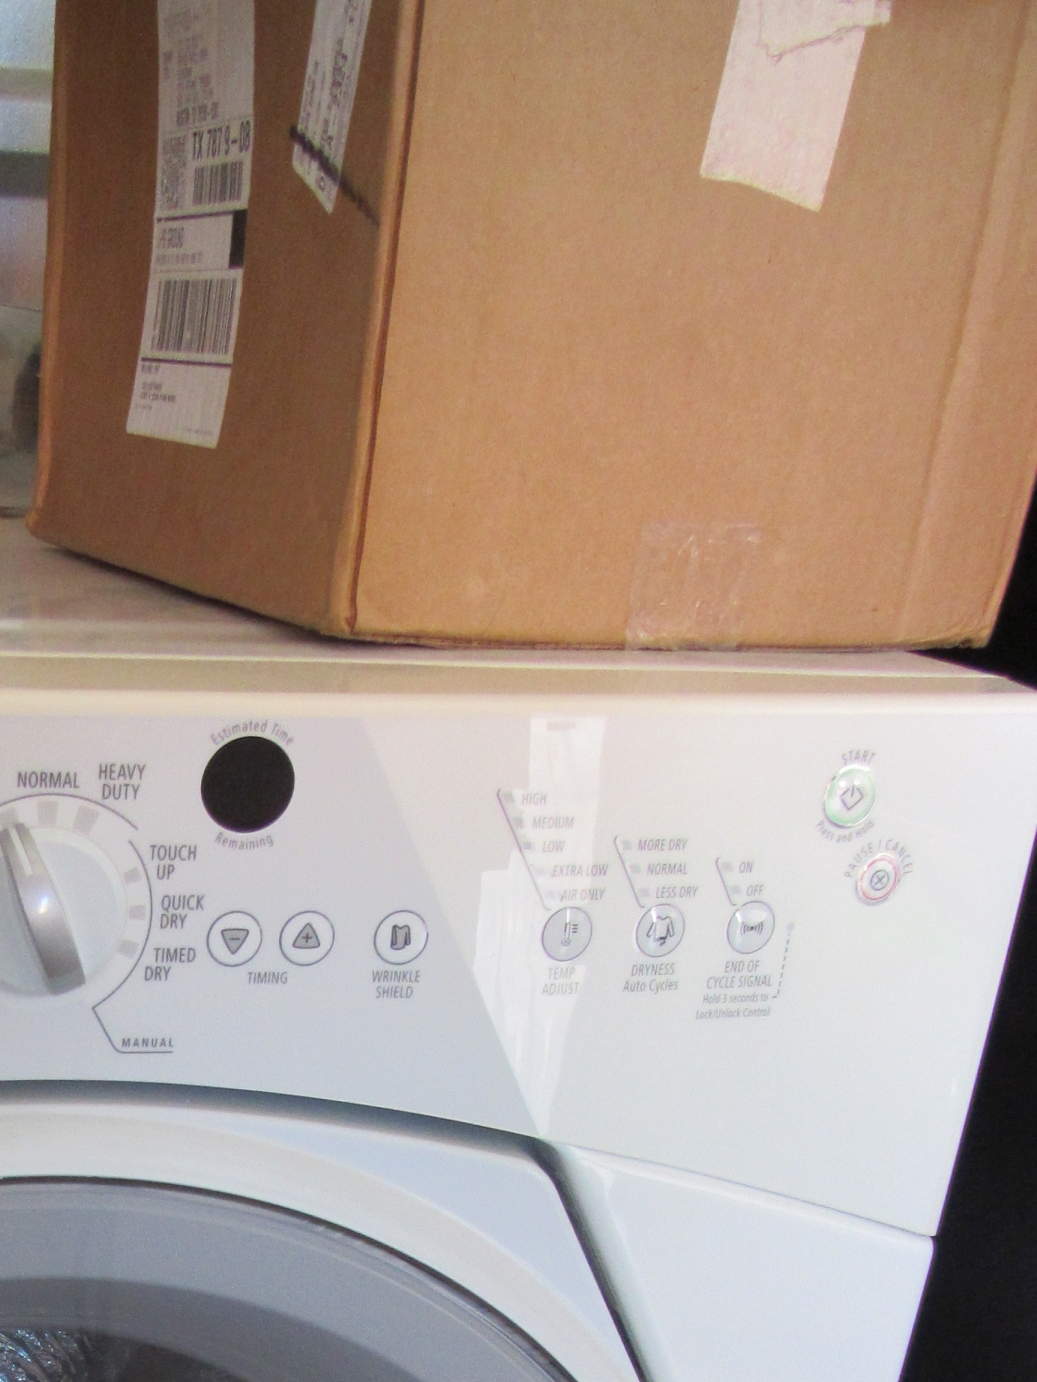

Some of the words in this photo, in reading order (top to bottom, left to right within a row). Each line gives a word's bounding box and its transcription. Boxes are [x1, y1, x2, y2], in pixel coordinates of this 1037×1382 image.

[210, 720, 268, 745] Estimated
[271, 723, 294, 745] Time
[842, 749, 876, 765] START
[98, 763, 147, 781] HEAVY
[17, 771, 81, 789] NORMAL
[101, 784, 142, 800] DUTY
[521, 793, 548, 806] HIGH
[532, 816, 575, 829] MEDIUM
[816, 819, 834, 841] Press
[836, 831, 852, 843] and
[214, 832, 274, 850] Remaining
[542, 841, 566, 853] LOW
[637, 838, 666, 851] MORE
[668, 838, 688, 851] DRY
[150, 844, 198, 862] TOUCH
[844, 842, 874, 878] PAUSE
[885, 839, 913, 877] CANCEL
[156, 864, 175, 881] UP
[551, 865, 583, 878] EXTRA
[586, 864, 609, 877] LOW
[647, 863, 688, 876] NORMAL
[739, 861, 754, 873] ON
[561, 889, 577, 902] AIR
[580, 889, 606, 902] ONLY
[656, 887, 677, 899] LESS
[679, 886, 699, 899] DRY
[746, 884, 765, 897] OFF
[161, 894, 205, 912] QUICK
[159, 914, 187, 930] DRY
[153, 947, 196, 964] TIMED
[144, 966, 172, 982] DRY
[547, 967, 576, 980] TEMP
[631, 963, 676, 976] DRYNESS
[724, 960, 745, 973] END
[747, 960, 760, 973] OF
[247, 971, 288, 985] TIMING
[372, 969, 421, 984] WRINKLE
[706, 976, 735, 989] CYCLE
[738, 974, 773, 988] SIGNAL
[376, 985, 414, 1000] SHIELD
[542, 981, 580, 996] ADJUST
[622, 979, 646, 993] Auto
[648, 979, 678, 994] Cycles
[702, 994, 721, 1004] Hold
[729, 993, 759, 1003] seconds
[742, 1007, 770, 1018] Control
[122, 1037, 175, 1049] MANUAL
